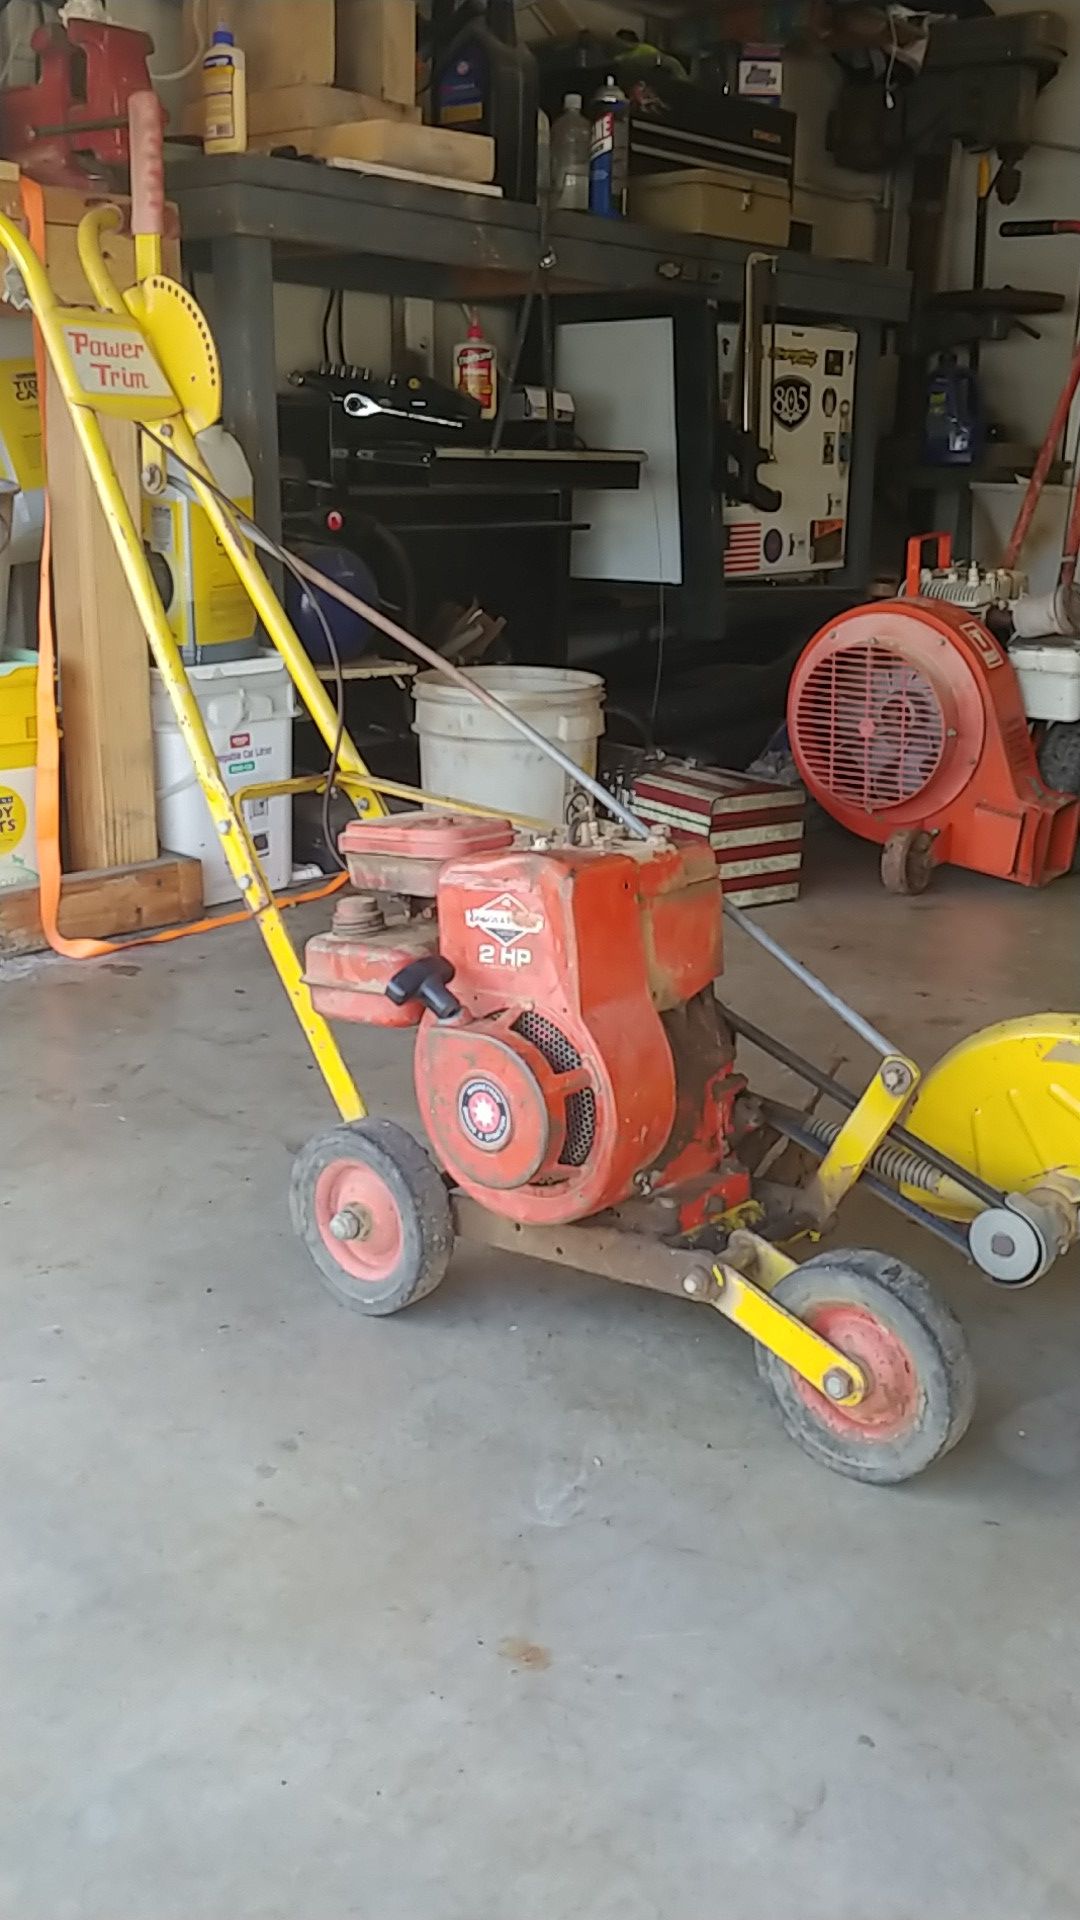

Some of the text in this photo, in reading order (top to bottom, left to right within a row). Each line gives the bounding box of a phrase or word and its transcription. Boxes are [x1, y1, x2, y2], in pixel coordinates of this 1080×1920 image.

[67, 331, 144, 359] Power
[13, 380, 38, 393] TID
[89, 362, 149, 389] Trim
[16, 390, 37, 401] CA
[772, 386, 808, 414] 805
[478, 943, 532, 969] 2 HP
